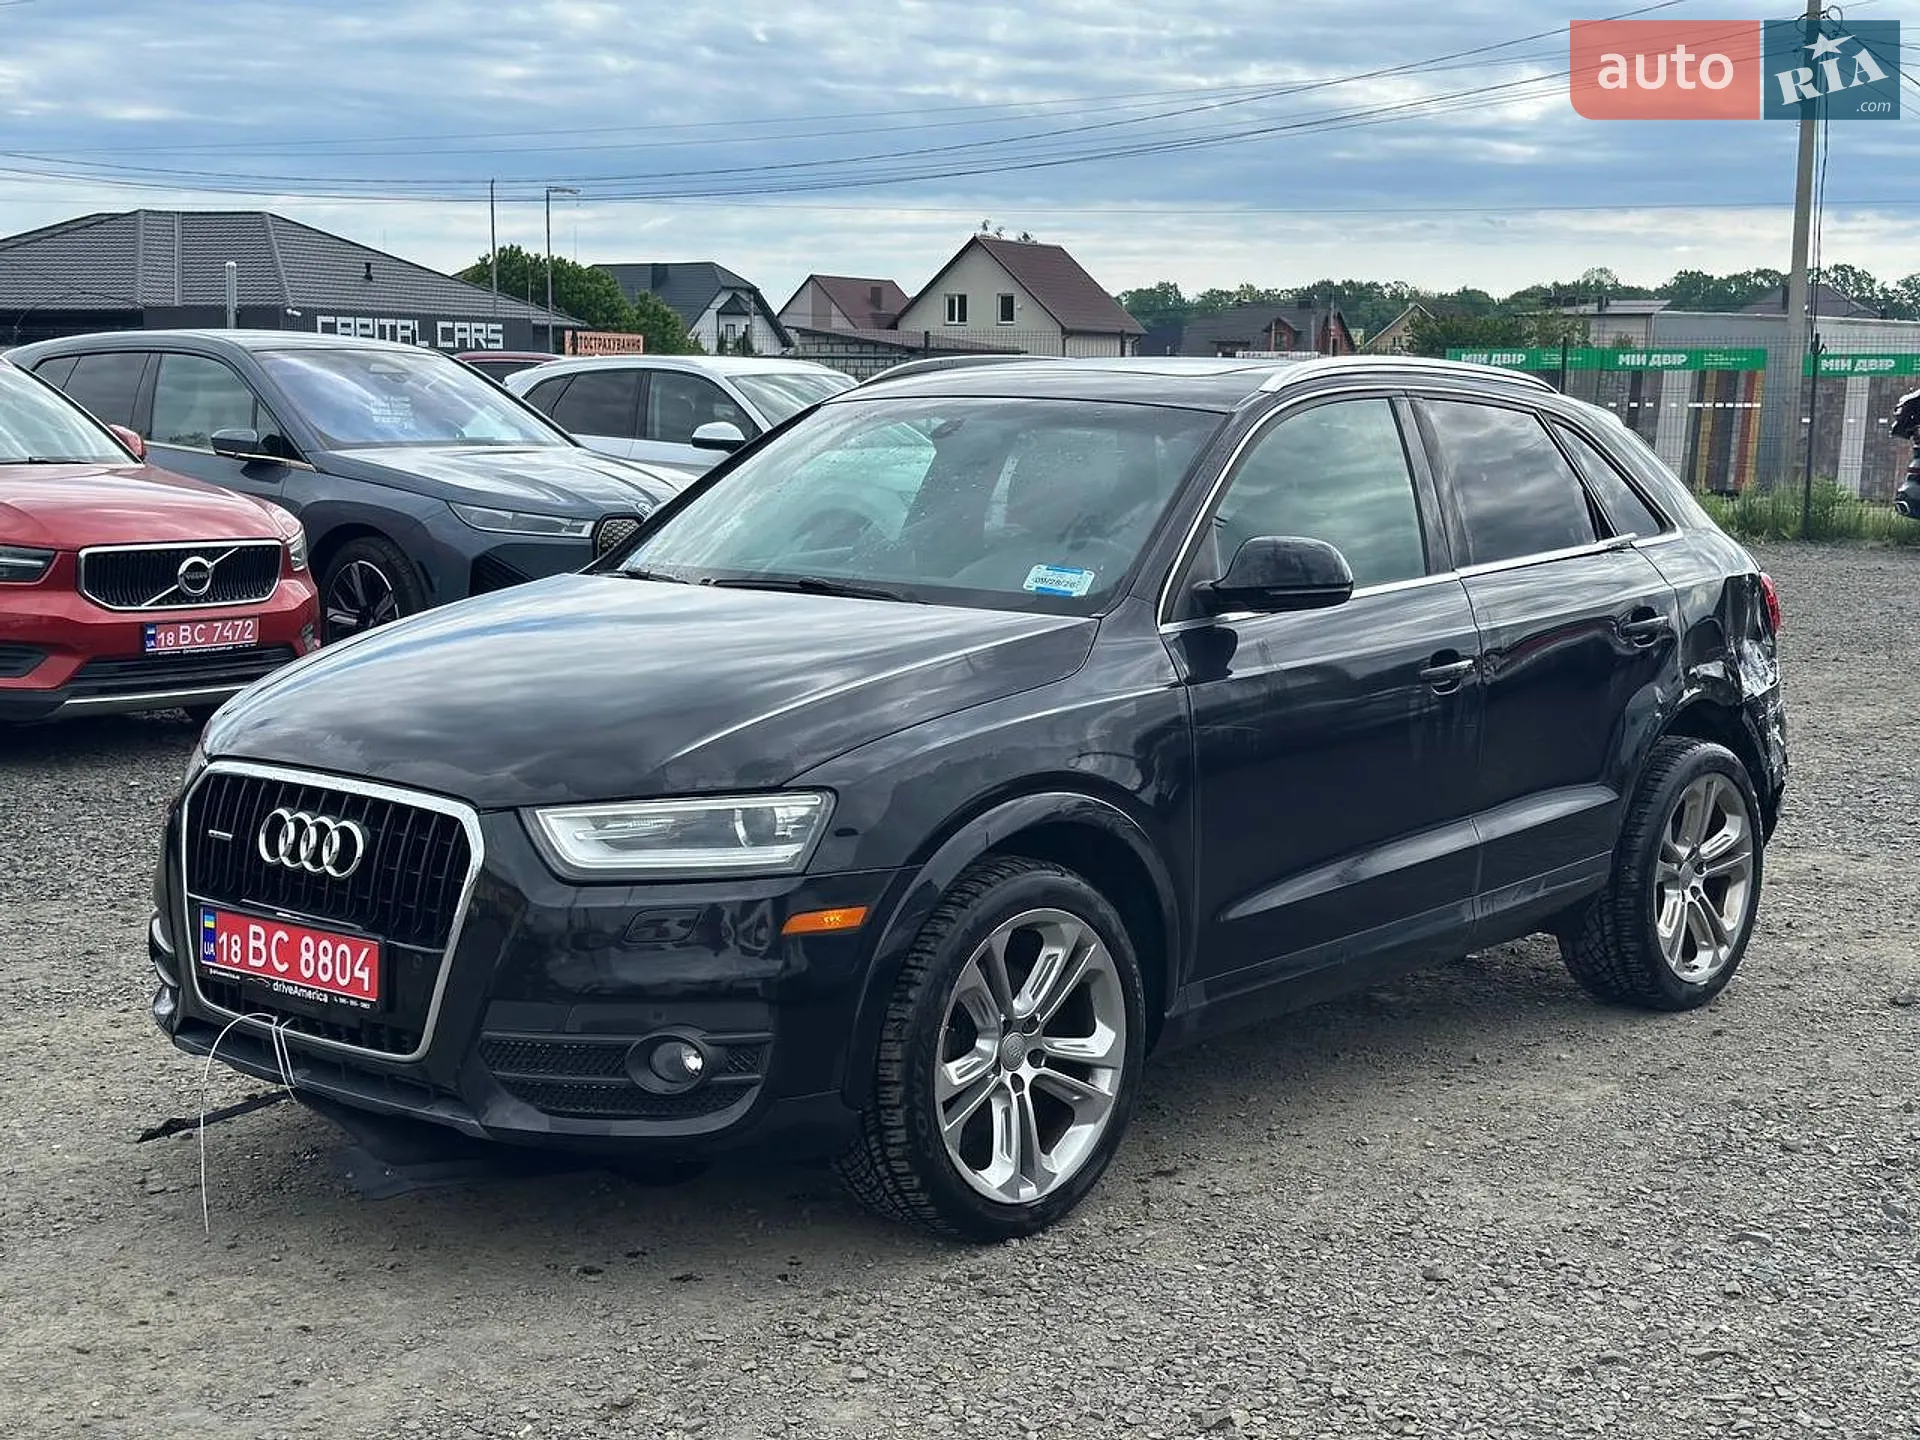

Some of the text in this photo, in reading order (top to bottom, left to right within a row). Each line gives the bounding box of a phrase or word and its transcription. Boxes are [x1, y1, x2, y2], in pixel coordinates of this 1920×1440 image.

[316, 316, 504, 349] CAPITAL CARS
[1490, 353, 1526, 366] ДВІР
[1648, 353, 1688, 367] ДВІР
[1853, 358, 1896, 372] ДВІР
[157, 620, 253, 646] 18 BC 7472
[203, 941, 215, 956] UA
[218, 924, 370, 992] 18 BC 8804
[272, 979, 329, 1004] driveAmerica
